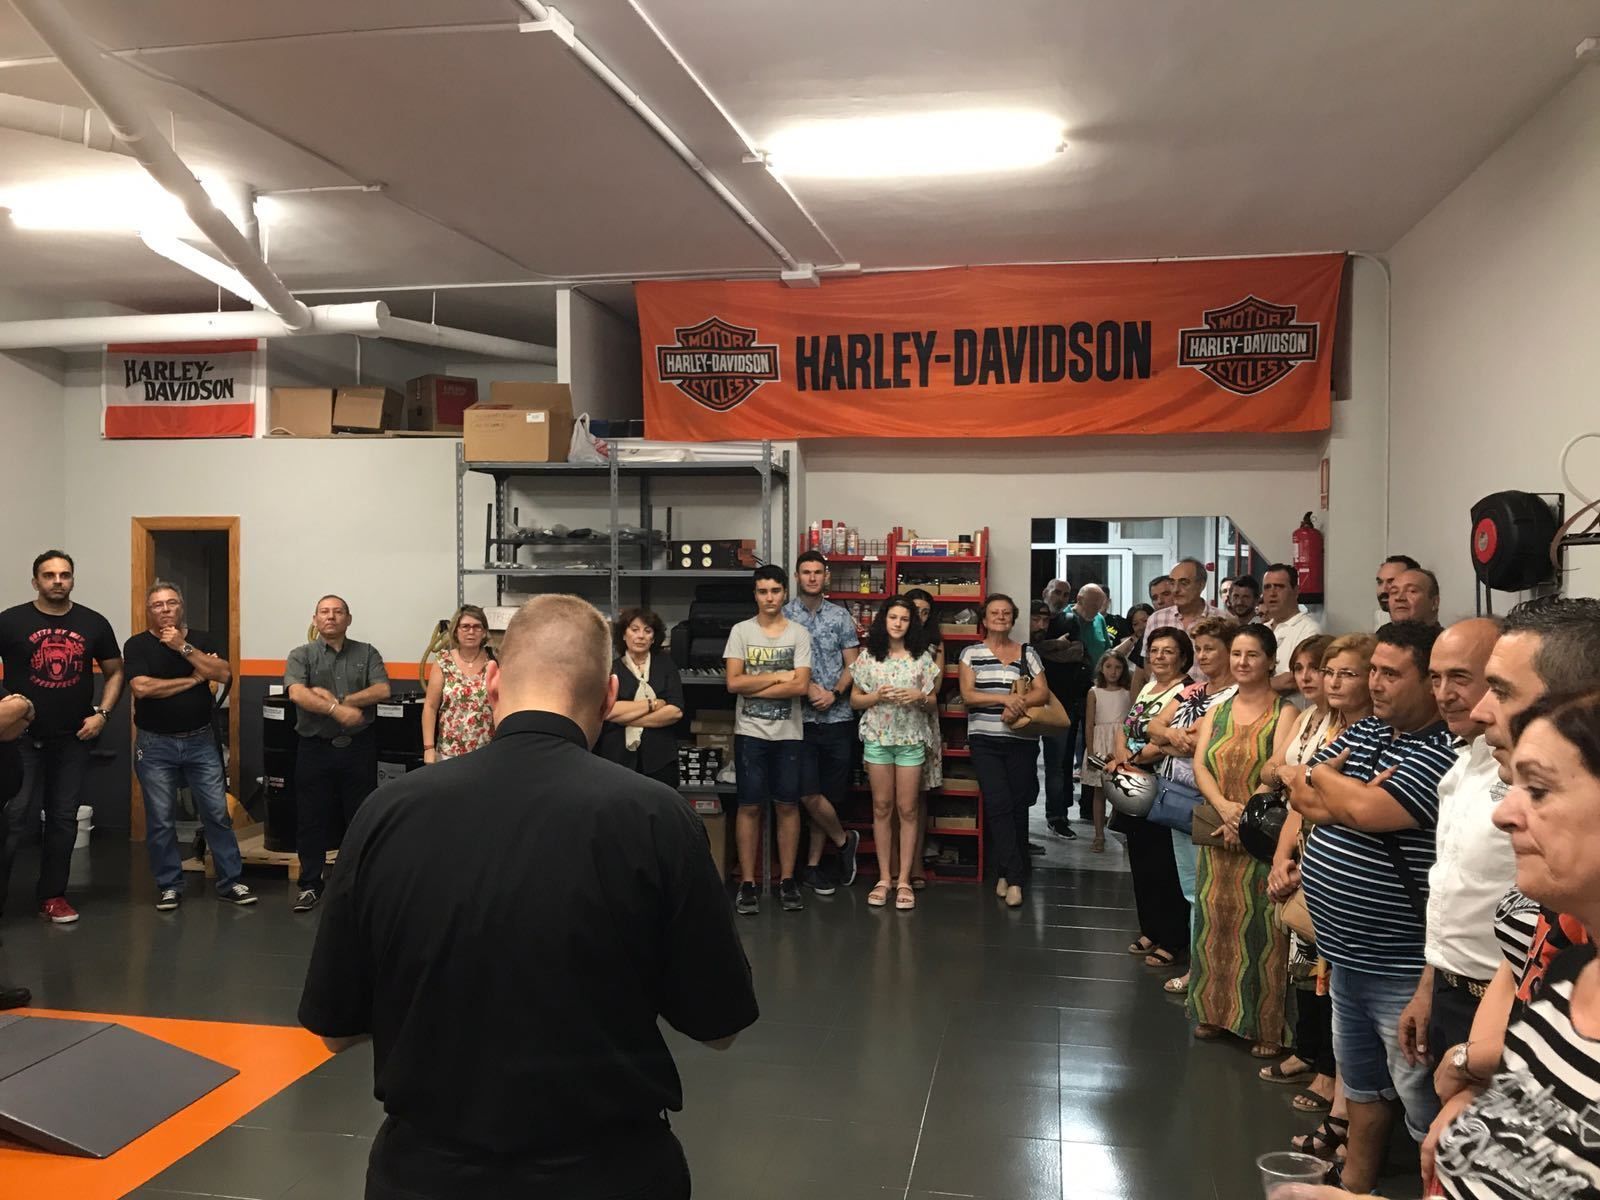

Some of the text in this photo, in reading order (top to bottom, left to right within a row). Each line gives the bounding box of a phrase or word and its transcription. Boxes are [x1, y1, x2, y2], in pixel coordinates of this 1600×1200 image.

[1220, 305, 1281, 329] MOTOR
[689, 326, 744, 348] MOTOR
[1190, 333, 1307, 357] HARLEY-DAVIDSON
[666, 354, 770, 373] HARLEY-DAVIDSON
[796, 320, 1152, 392] HARLEY-DAVIDSON
[123, 360, 215, 389] HARLEY-
[1217, 361, 1278, 386] CYCLES
[144, 378, 234, 401] DAVIDSON
[692, 379, 744, 403] CYCLES
[746, 647, 795, 660] LONDON
